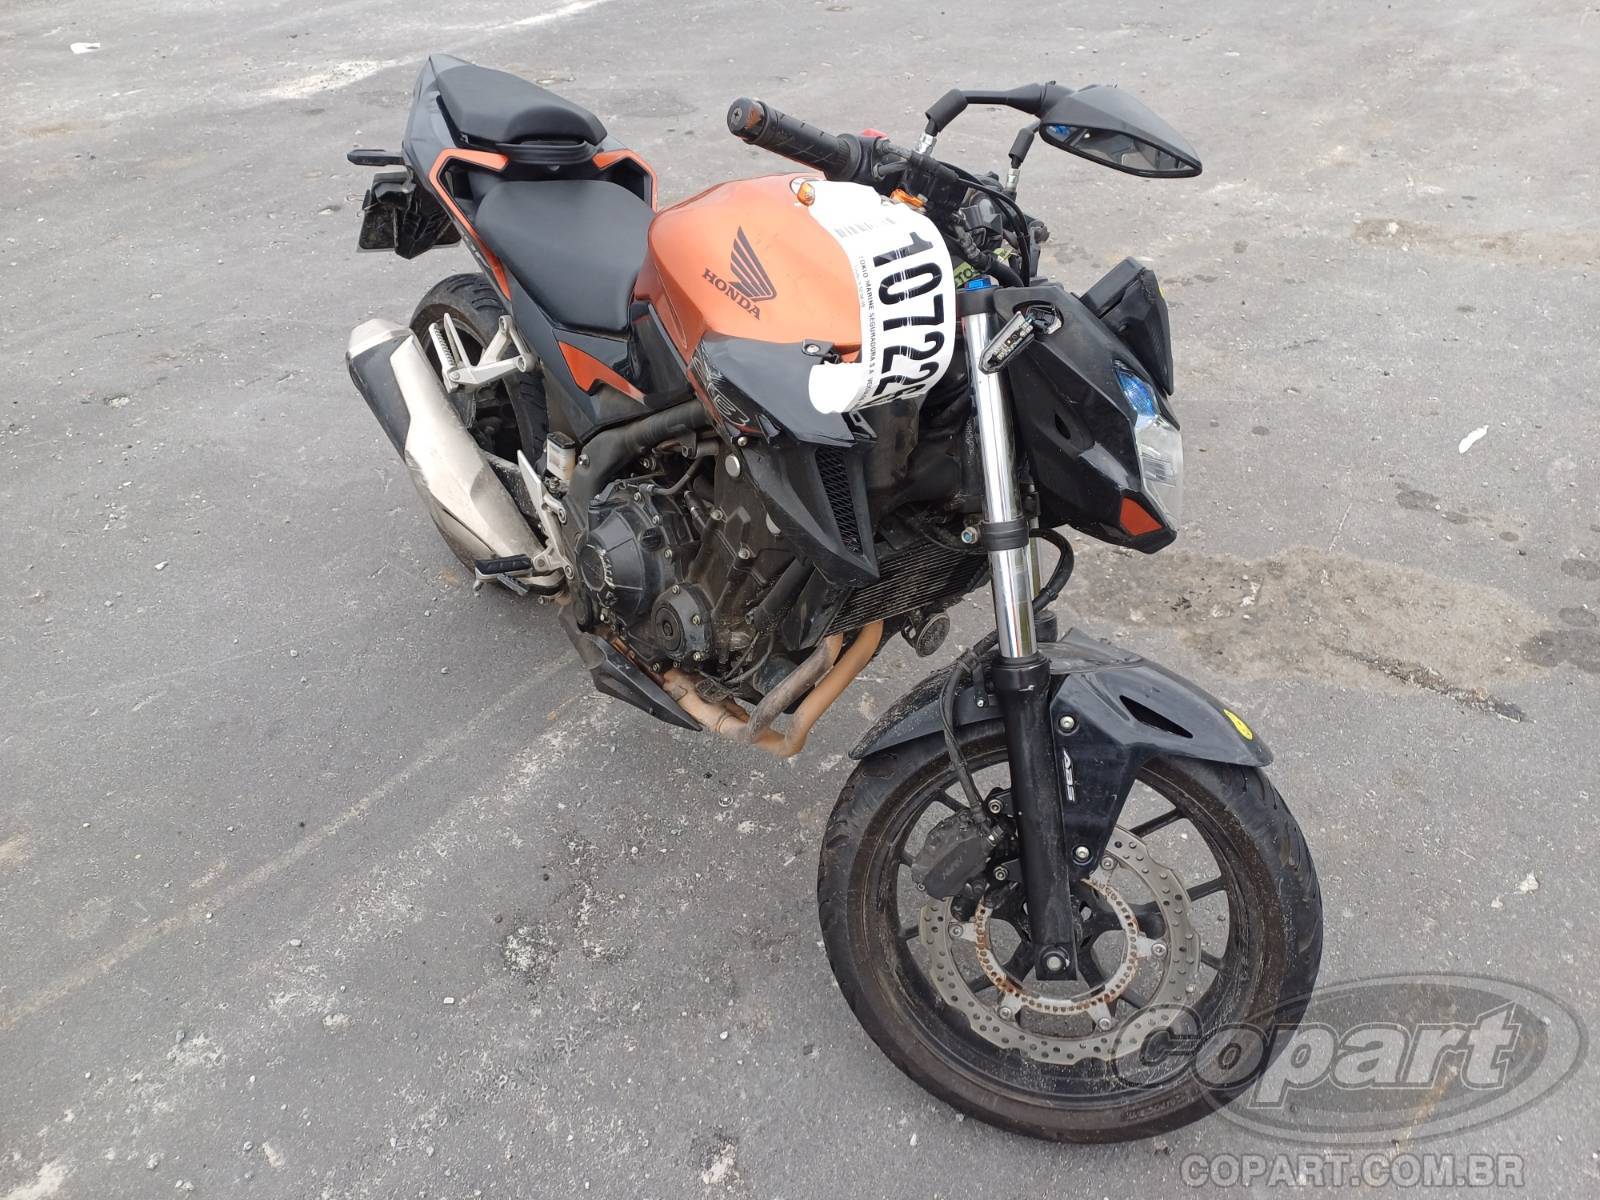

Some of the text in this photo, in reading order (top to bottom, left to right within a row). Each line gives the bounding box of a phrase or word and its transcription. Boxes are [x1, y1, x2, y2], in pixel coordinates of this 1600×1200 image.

[702, 267, 761, 320] HONDA
[864, 280, 875, 310] MARINE
[1062, 747, 1076, 802] ABS
